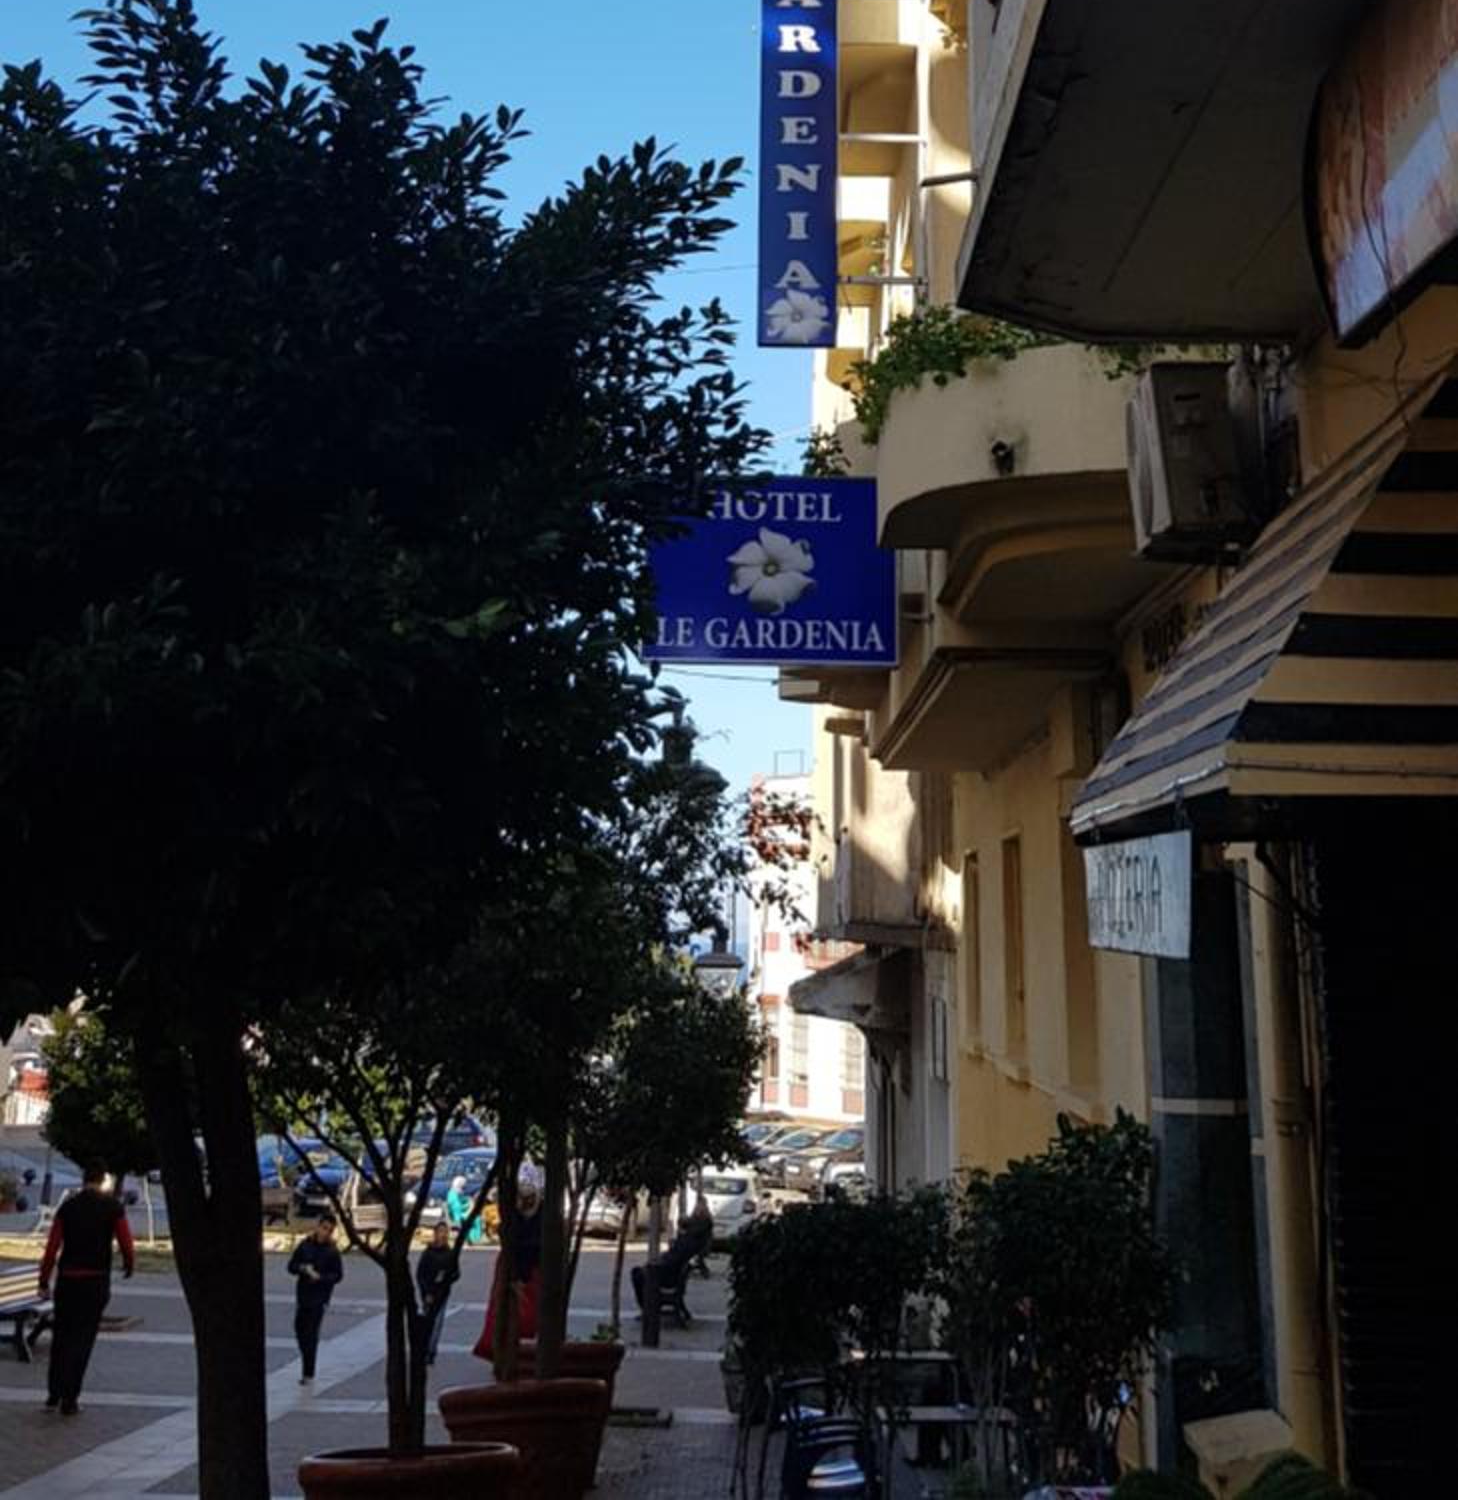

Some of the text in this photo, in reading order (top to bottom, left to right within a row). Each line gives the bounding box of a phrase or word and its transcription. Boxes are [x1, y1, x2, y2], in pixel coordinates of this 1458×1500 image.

[706, 491, 841, 521] HOTEL
[657, 617, 884, 650] LE GARDENIA
